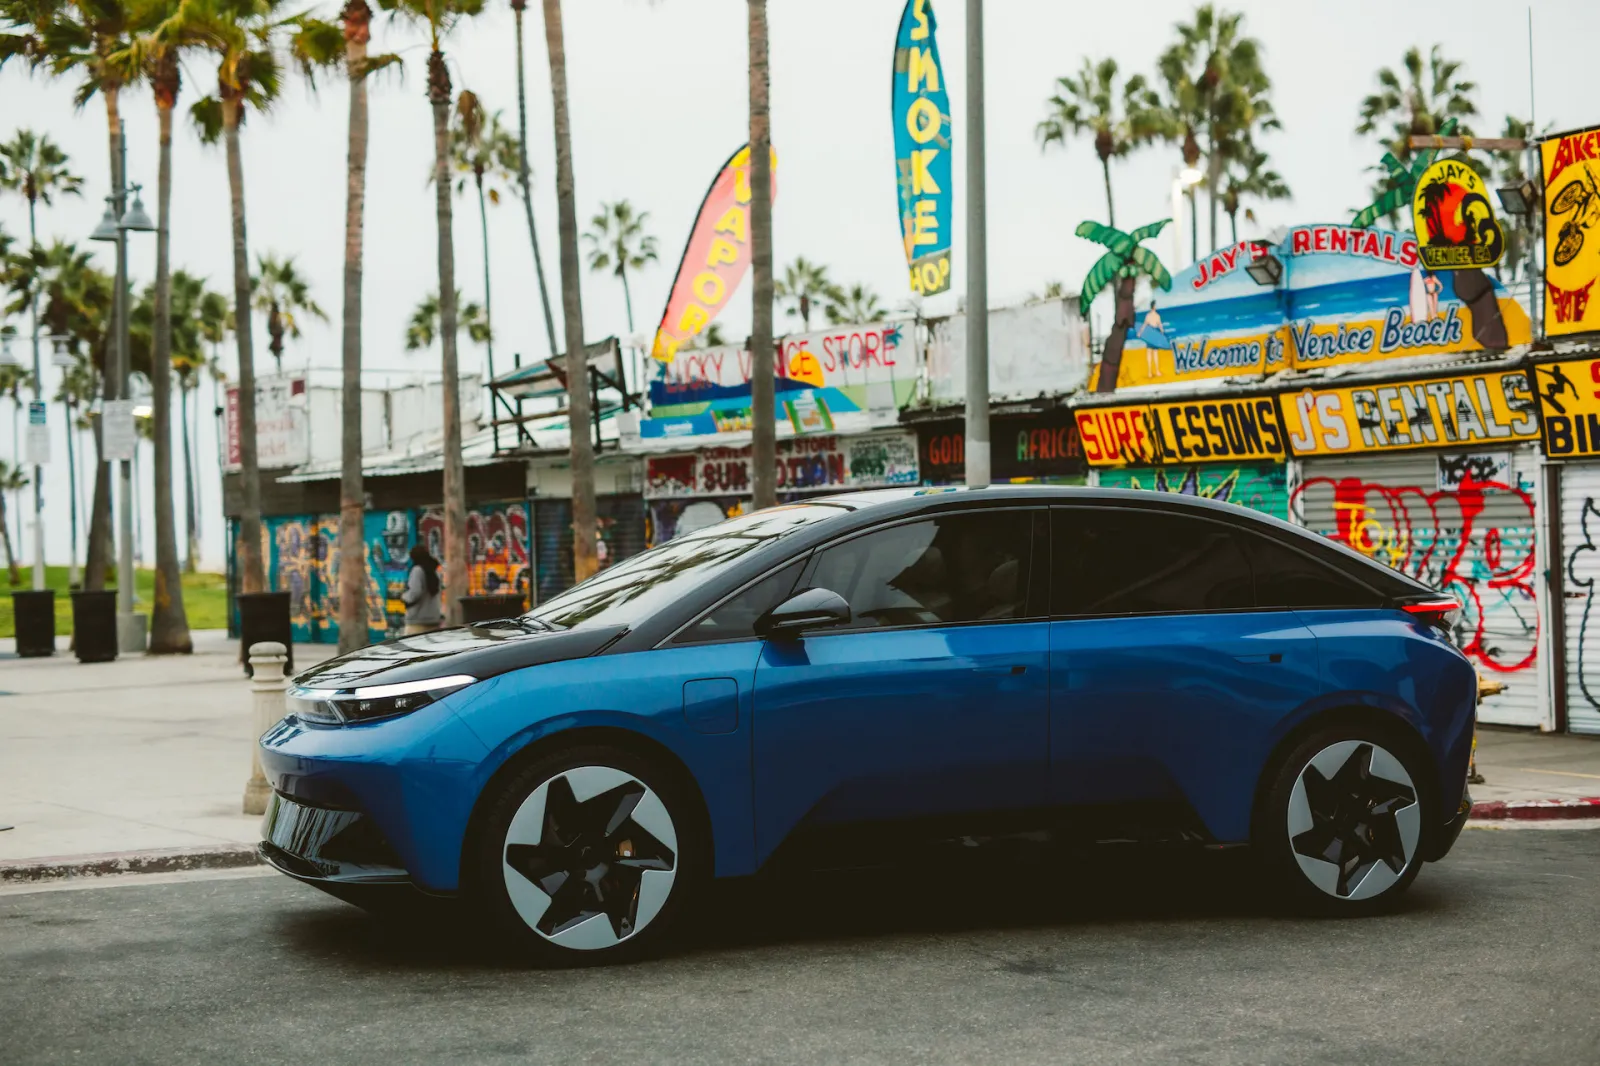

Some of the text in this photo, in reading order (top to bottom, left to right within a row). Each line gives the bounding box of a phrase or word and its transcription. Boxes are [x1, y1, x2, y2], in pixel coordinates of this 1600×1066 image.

[906, 0, 941, 245] SMOKE
[1437, 164, 1476, 190] JAY'S
[1546, 131, 1600, 189] BIKE
[1292, 227, 1419, 268] RENTALS
[909, 258, 949, 296] HOP
[665, 350, 723, 393] LUCKY
[823, 329, 895, 371] STORE
[1171, 305, 1461, 373] Welcome to Venice Beach
[1077, 400, 1283, 462] SURF LESSONS
[1291, 388, 1350, 450] J'S
[1352, 373, 1539, 447] RENTALS
[794, 435, 837, 455] STORE
[1017, 427, 1080, 461] AFRICA
